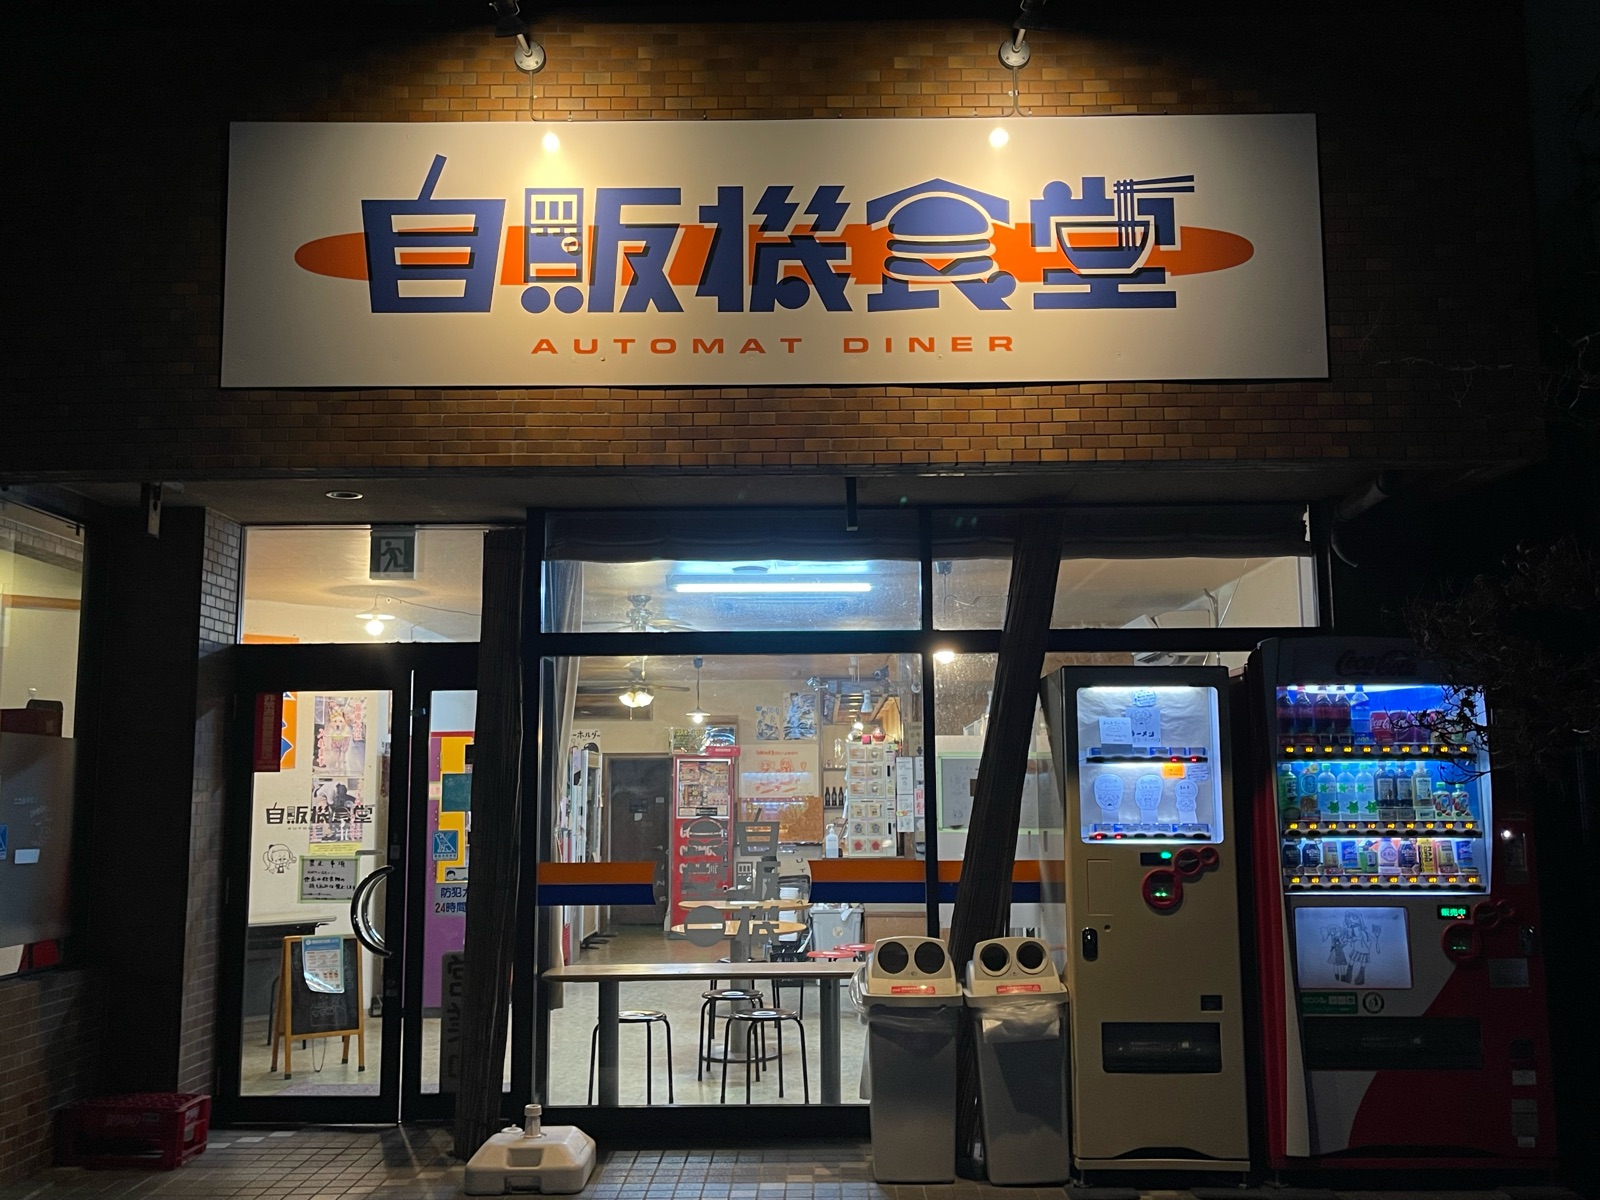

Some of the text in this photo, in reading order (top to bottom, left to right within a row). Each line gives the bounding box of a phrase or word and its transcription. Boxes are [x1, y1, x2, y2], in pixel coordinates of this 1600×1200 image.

[362, 154, 1194, 314] 自販機食堂
[530, 334, 1015, 356] AUTOMAT DINER
